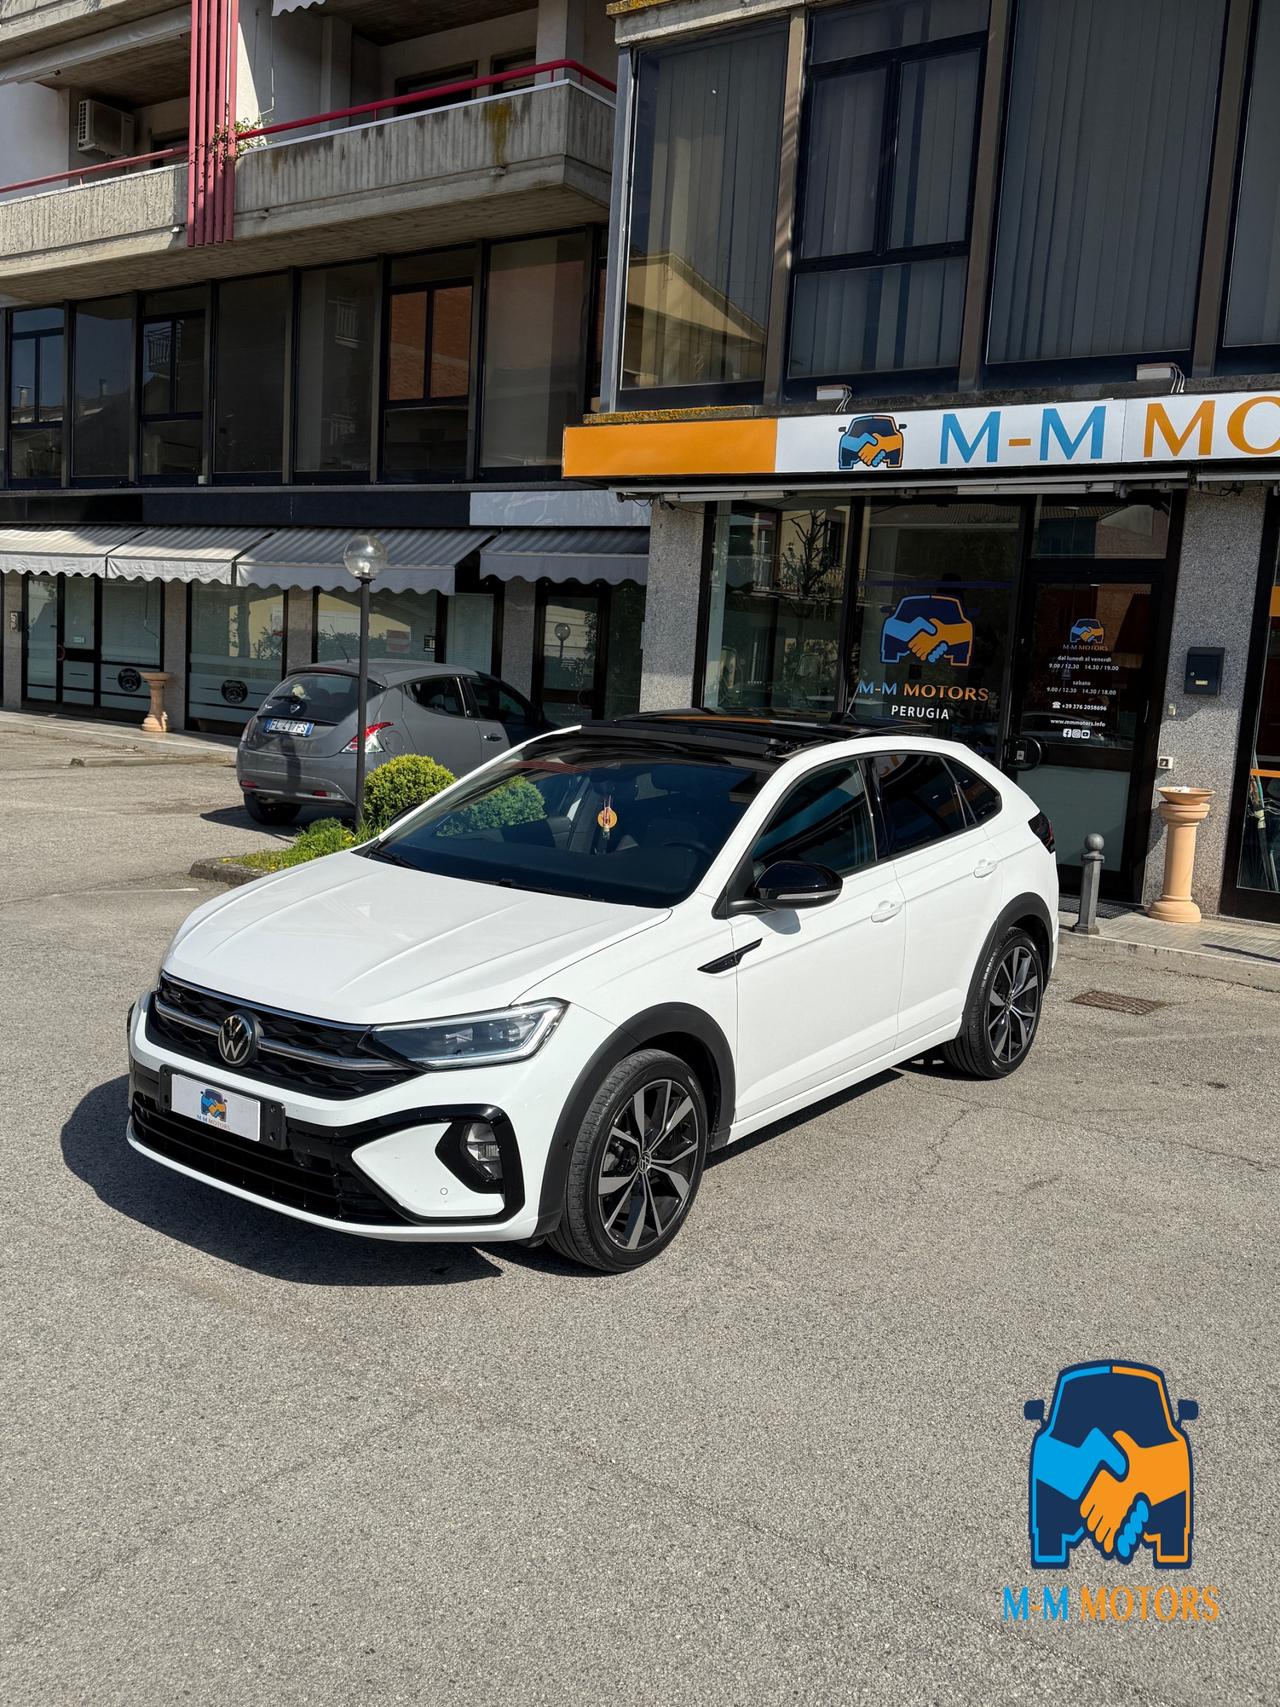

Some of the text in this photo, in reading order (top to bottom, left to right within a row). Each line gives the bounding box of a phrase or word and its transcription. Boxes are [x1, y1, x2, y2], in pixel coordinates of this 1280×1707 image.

[939, 405, 1107, 464] M-M
[1078, 644, 1109, 652] MOTORS
[858, 681, 989, 701] M-M MOTORS
[891, 705, 950, 720] PERUGIA
[208, 1118, 231, 1131] MOTORS
